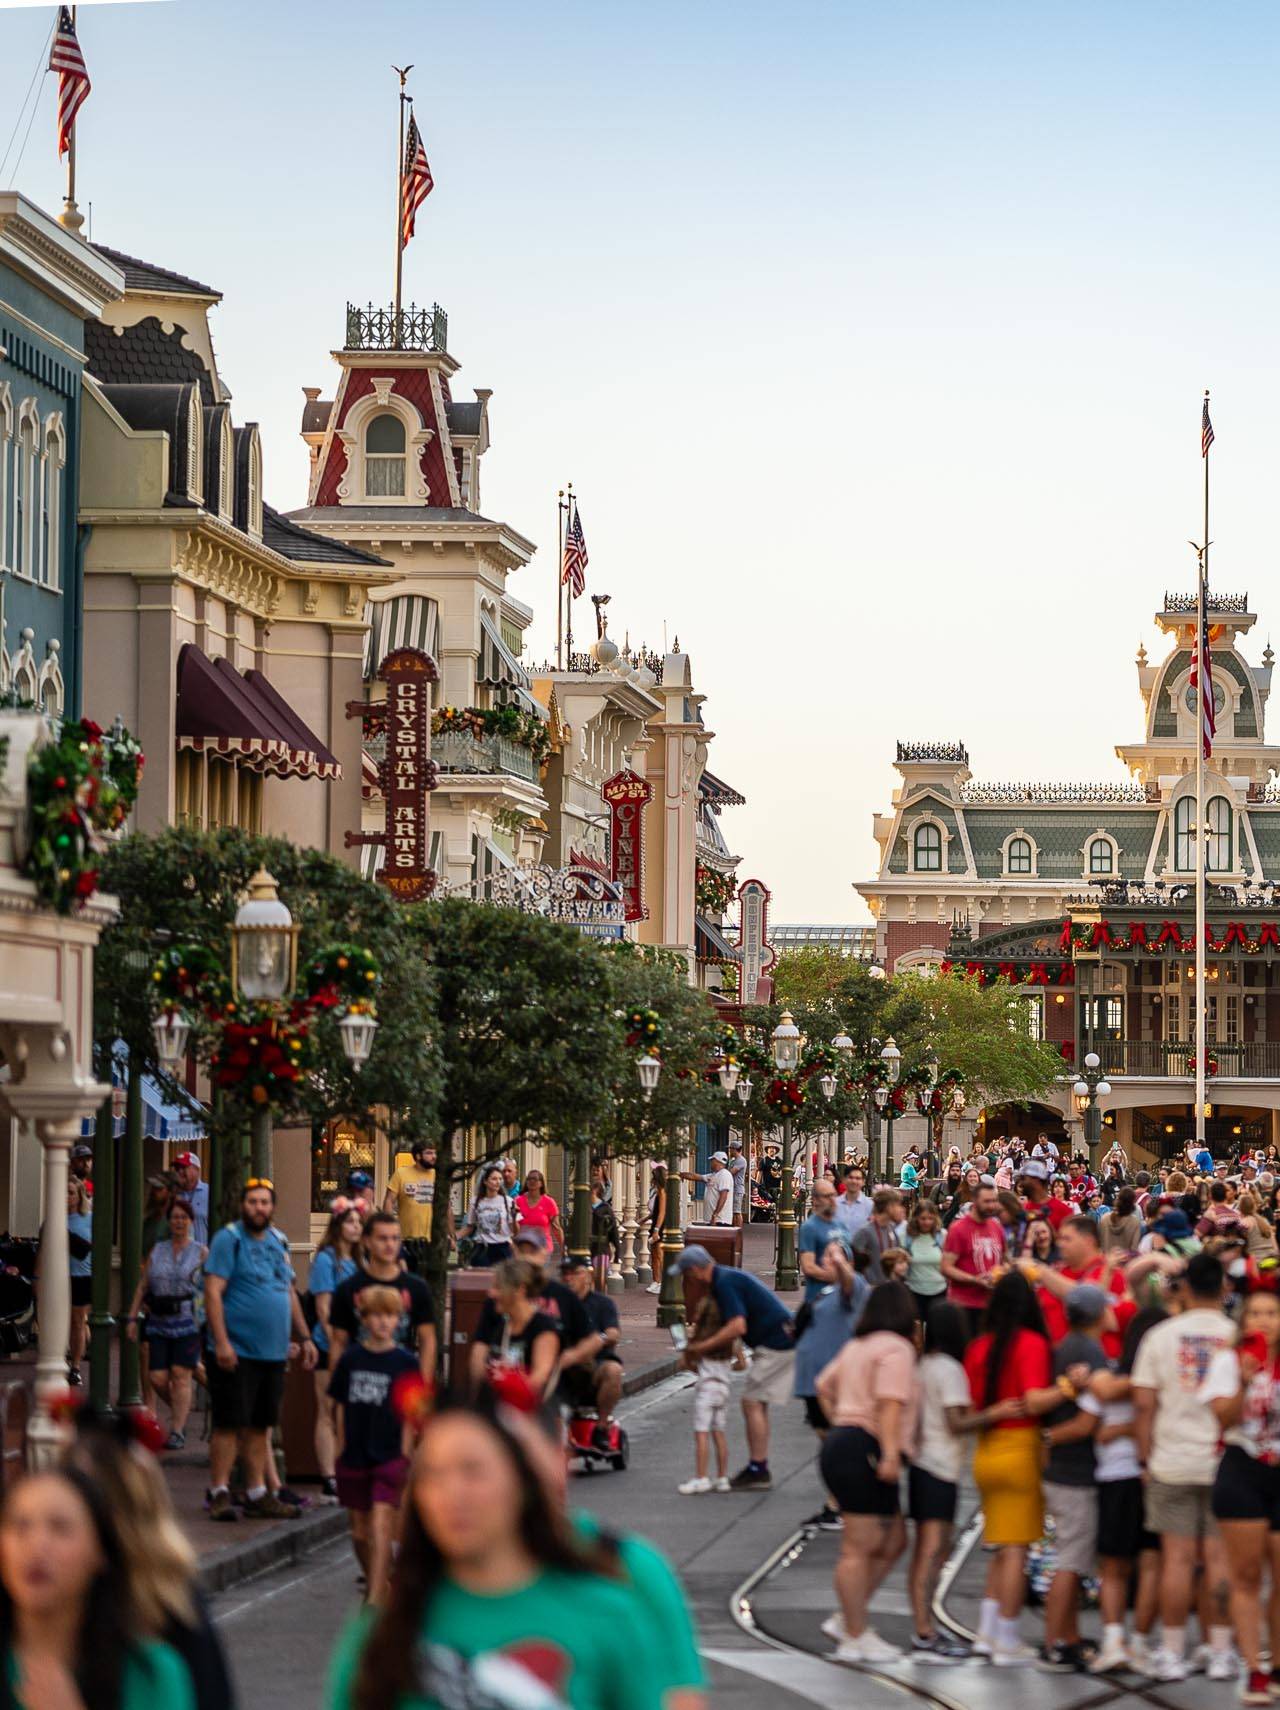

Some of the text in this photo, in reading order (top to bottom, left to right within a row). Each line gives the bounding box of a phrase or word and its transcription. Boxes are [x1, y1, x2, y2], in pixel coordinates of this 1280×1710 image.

[394, 683, 418, 868] CRYSTAL ARTS
[606, 782, 644, 797] MAIN
[628, 789, 648, 798] ST.
